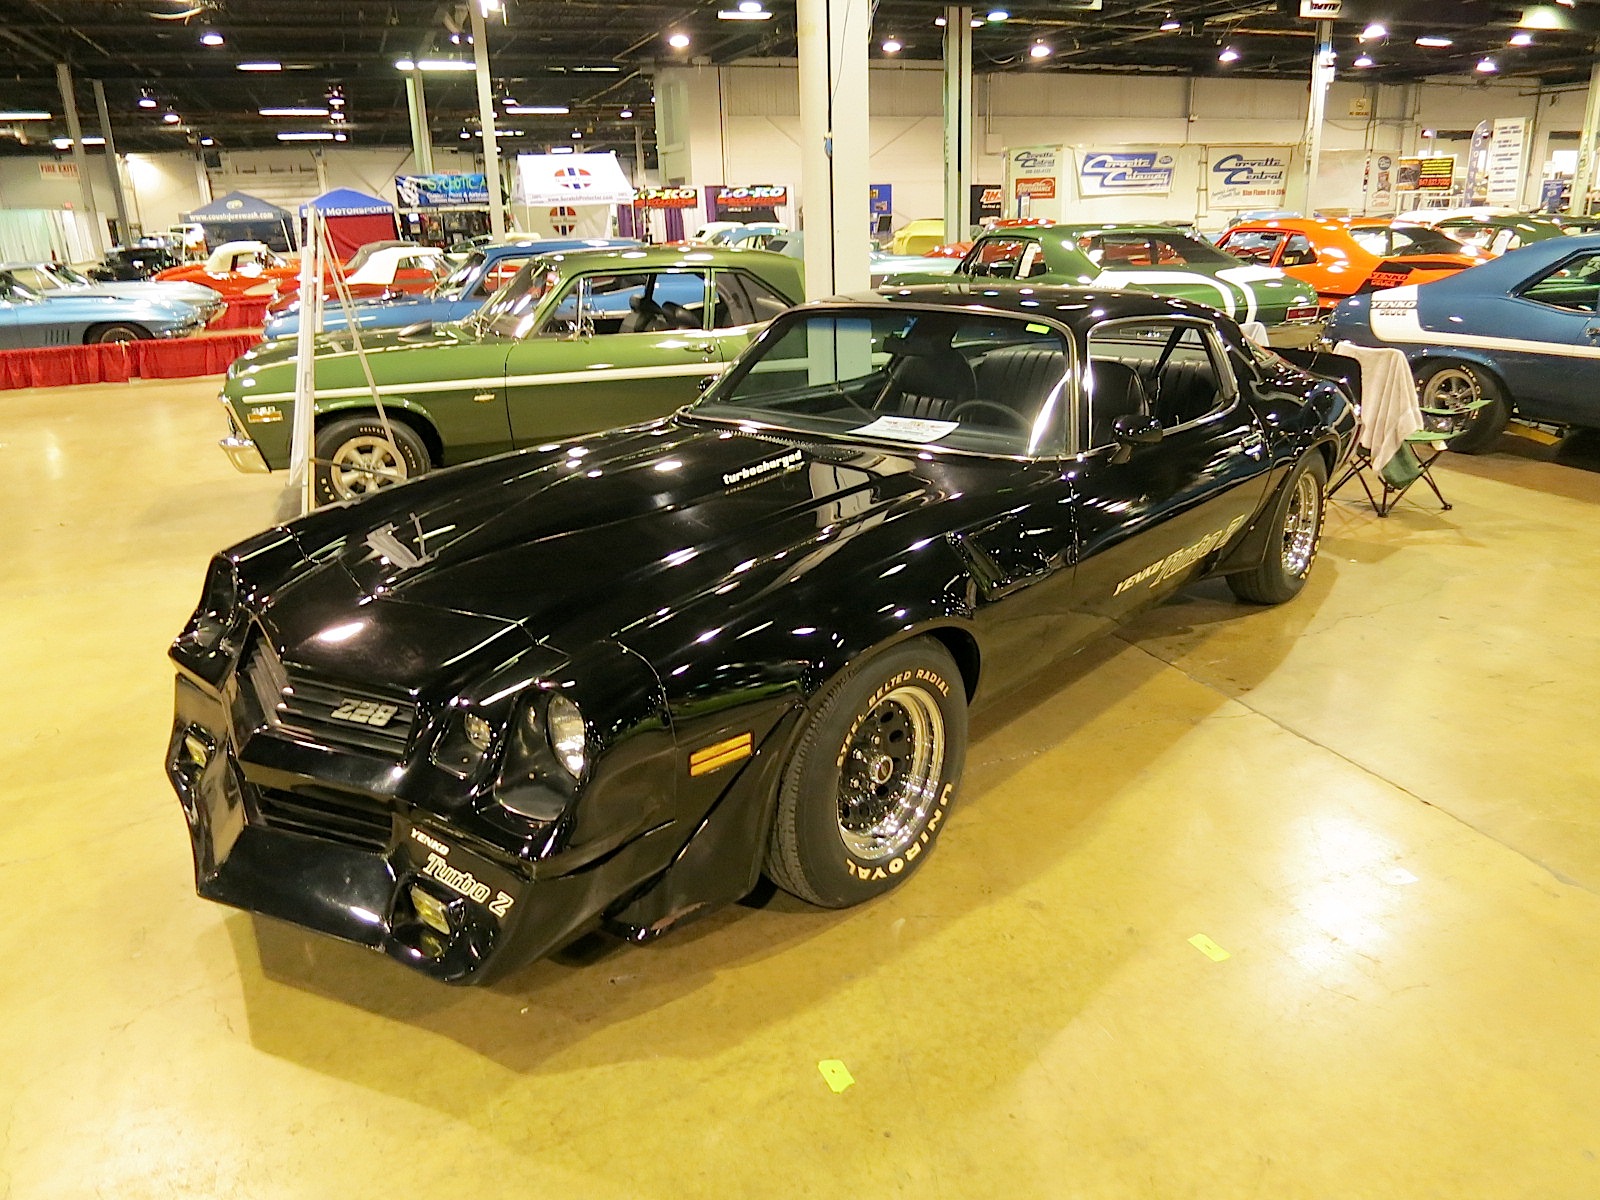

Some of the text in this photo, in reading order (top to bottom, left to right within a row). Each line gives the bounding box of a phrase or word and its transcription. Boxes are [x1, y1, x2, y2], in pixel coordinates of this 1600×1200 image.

[1083, 155, 1151, 172] Corvette
[1213, 154, 1284, 172] Corvette
[1224, 167, 1283, 185] Central
[719, 186, 785, 198] LO-KO
[326, 205, 393, 217] MOTORSPORTS
[1370, 301, 1417, 309] YENKO
[723, 449, 802, 485] turbocharged
[1113, 559, 1164, 597] YENKO
[868, 670, 912, 707] BELTED
[916, 669, 951, 698] RADIAL
[331, 697, 399, 727] Z28
[410, 827, 450, 856] YENKO
[846, 783, 953, 881] UNIROYAL
[422, 852, 515, 918] Turbo Z
